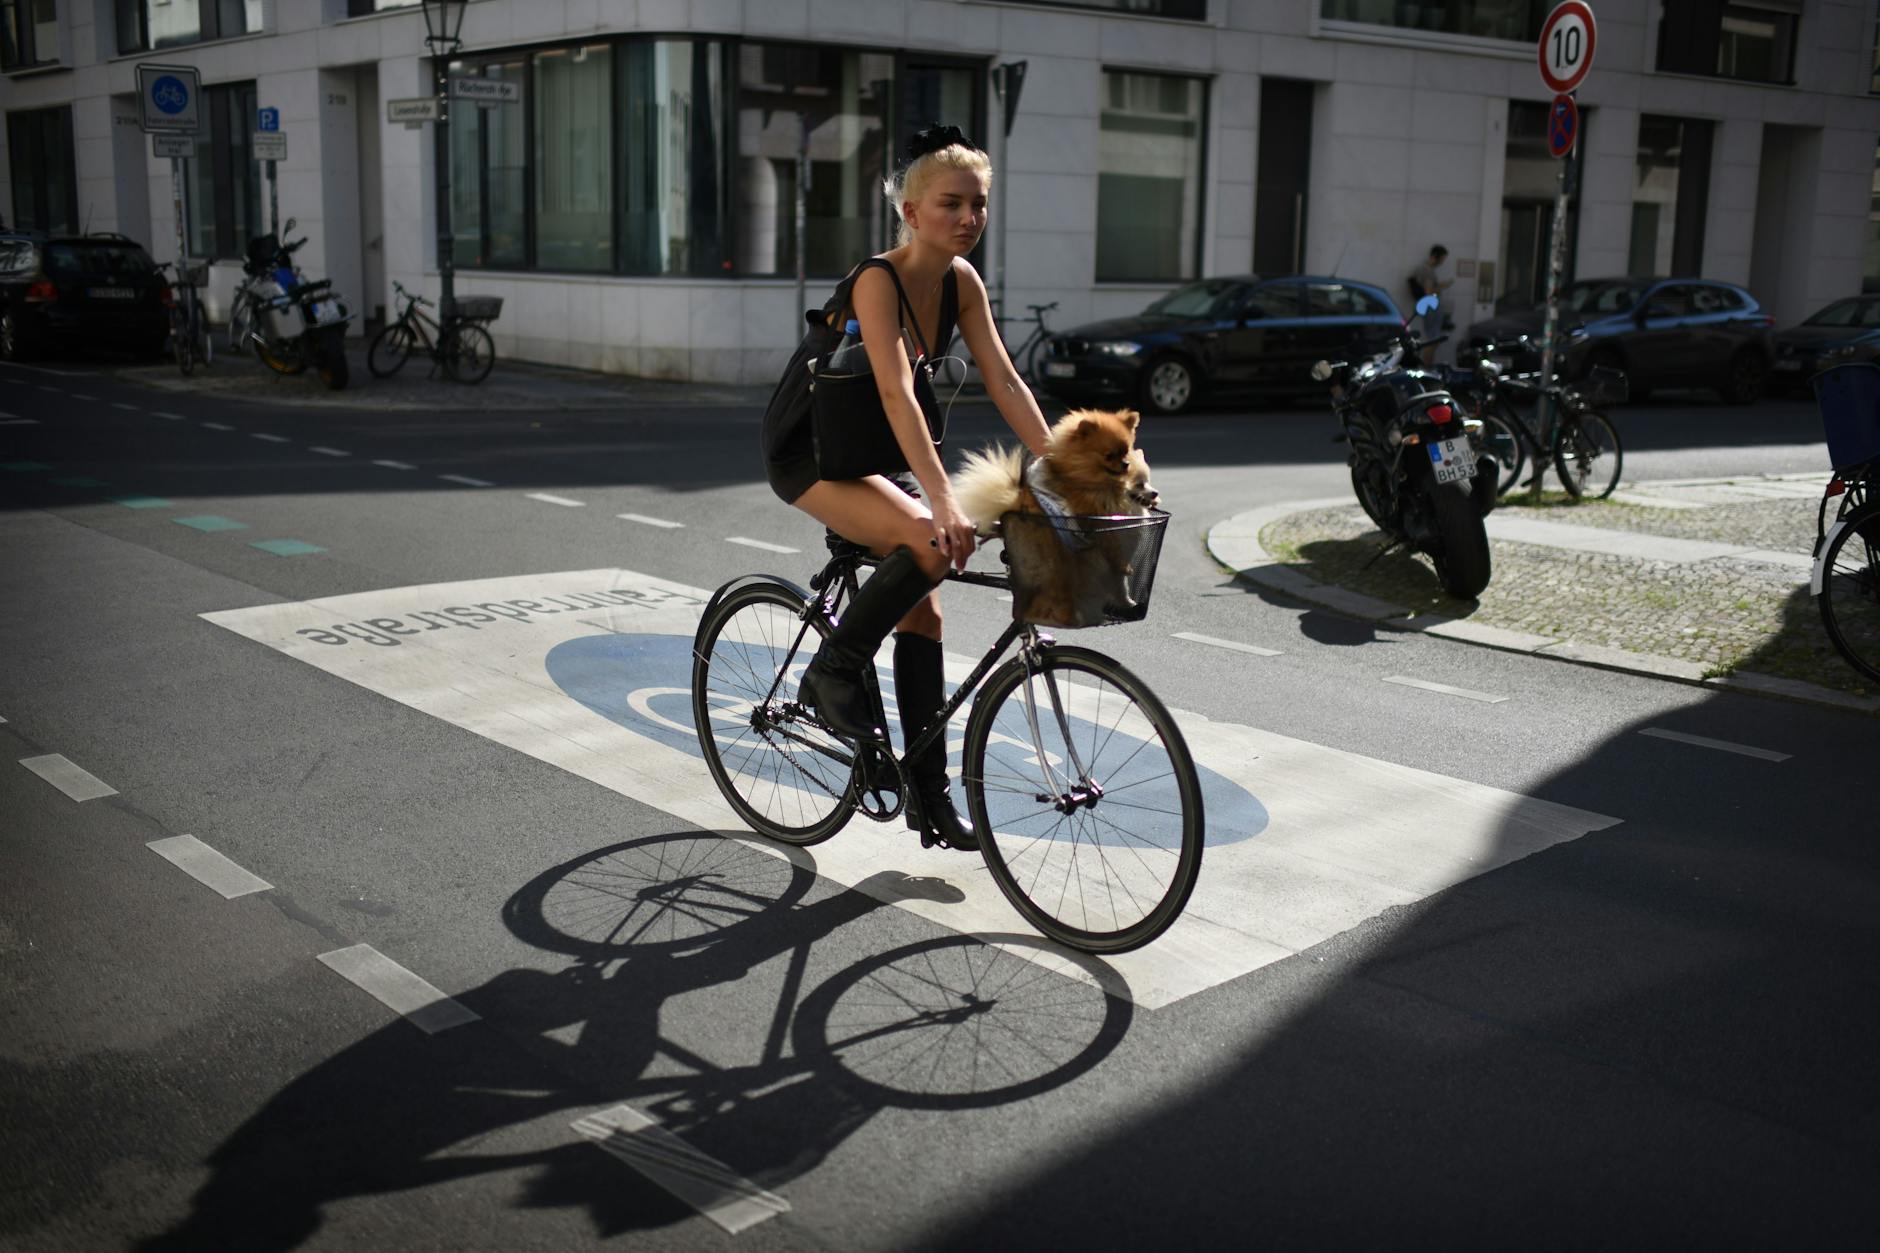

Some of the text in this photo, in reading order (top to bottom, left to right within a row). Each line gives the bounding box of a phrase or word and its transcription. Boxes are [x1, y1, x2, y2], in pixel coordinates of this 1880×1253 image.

[1553, 25, 1581, 68] 10
[1445, 440, 1455, 453] B
[1437, 467, 1456, 481] BH
